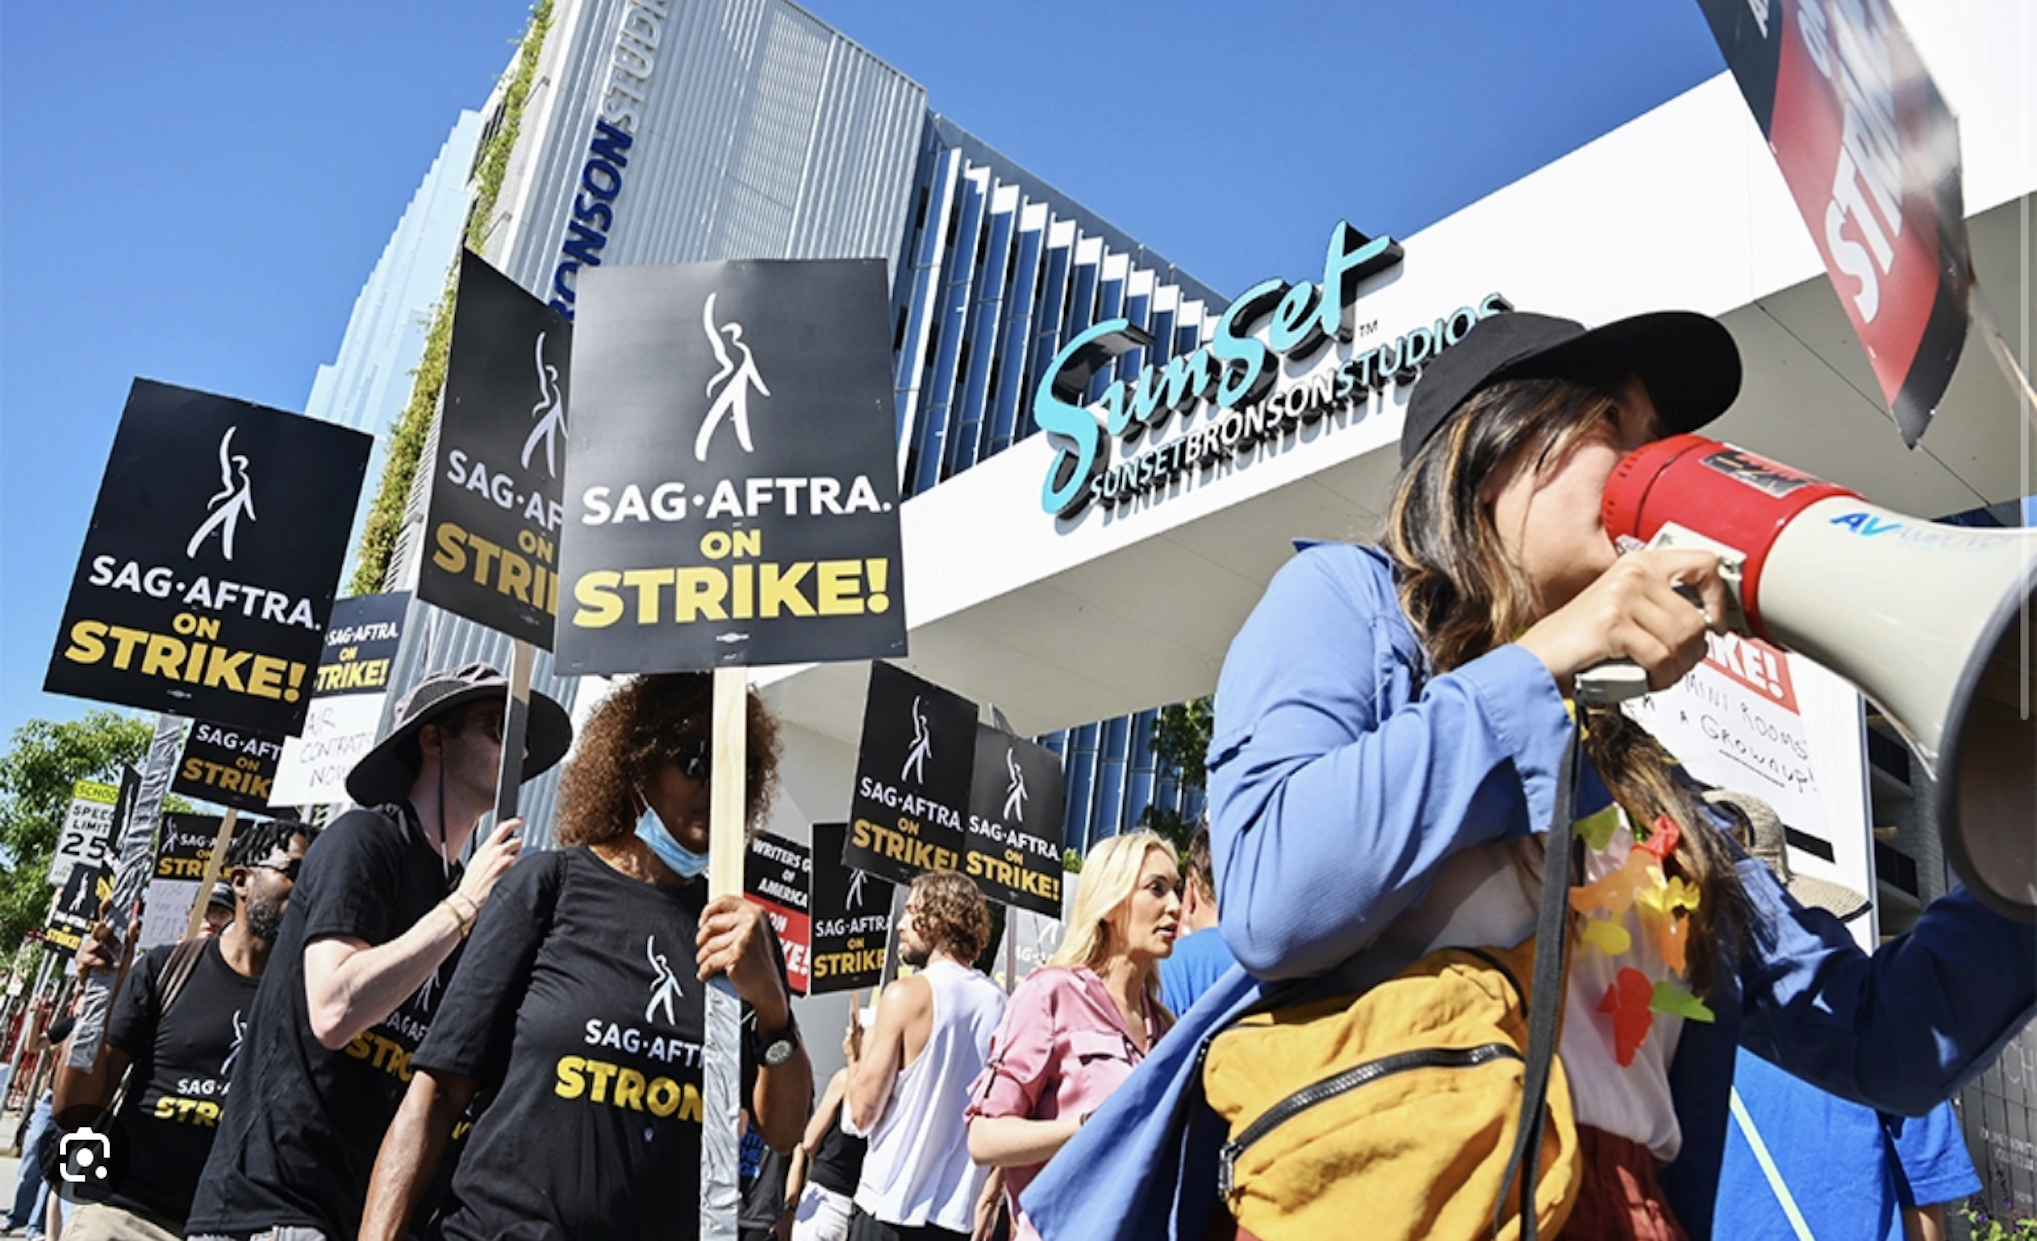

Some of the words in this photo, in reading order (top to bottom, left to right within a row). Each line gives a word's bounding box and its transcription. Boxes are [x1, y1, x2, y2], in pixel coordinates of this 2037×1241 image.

[517, 529, 555, 563] ON
[700, 529, 761, 559] ON
[432, 522, 557, 618] STRI
[572, 557, 890, 629] STRIKE!
[172, 612, 222, 642] ON
[65, 619, 307, 703] STRIKE!
[339, 646, 359, 661] ON
[313, 658, 390, 692] TRIKE!
[235, 756, 260, 771] ON
[73, 819, 110, 834] LIMIT
[897, 817, 919, 836] ON
[61, 832, 107, 860] 25
[752, 837, 801, 869] WRITERS
[852, 818, 959, 875] STRIKE!
[1004, 848, 1024, 866] ON
[966, 850, 1060, 902] STRIKE!
[757, 877, 808, 908] AMERICA
[847, 937, 864, 950] ON
[153, 1095, 225, 1128] STR
